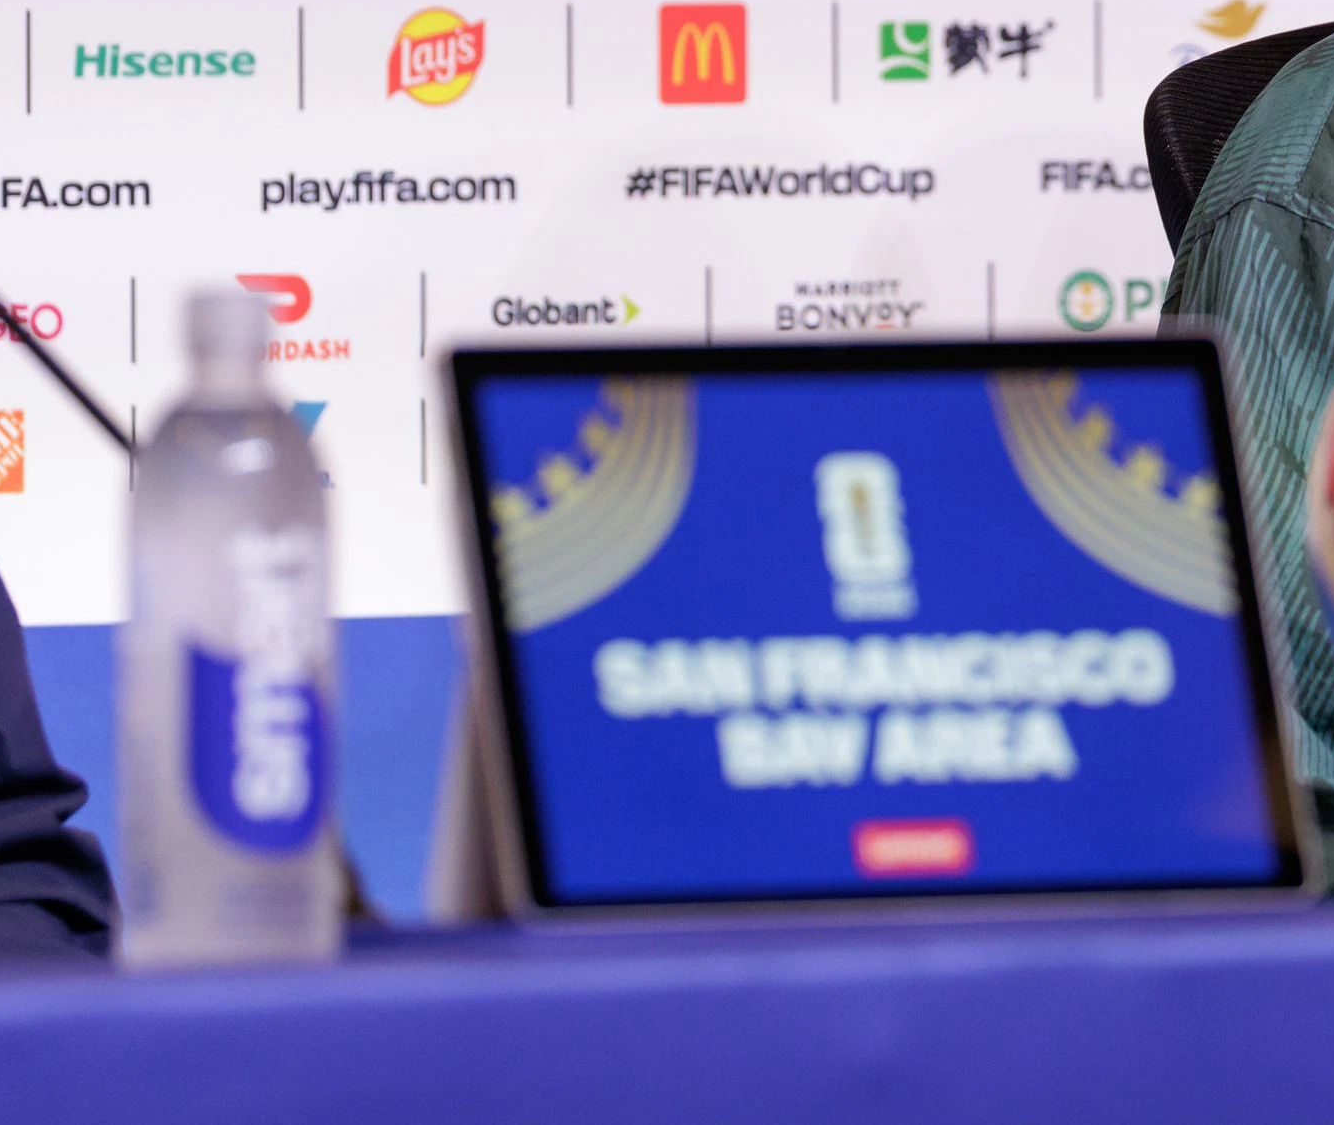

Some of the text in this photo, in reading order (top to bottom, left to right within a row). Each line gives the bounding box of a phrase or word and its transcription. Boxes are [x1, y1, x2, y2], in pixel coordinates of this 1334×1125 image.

[75, 44, 255, 77] Hisense
[262, 171, 516, 212] play.fifa.com
[625, 164, 935, 200] #FIFAWorldCup
[1039, 159, 1151, 193] FIFA.c
[492, 297, 616, 328] Globant
[775, 299, 917, 333] BONVOY
[595, 629, 1175, 719] SAN FRANCISCO
[715, 707, 1079, 789] BAY AREA
